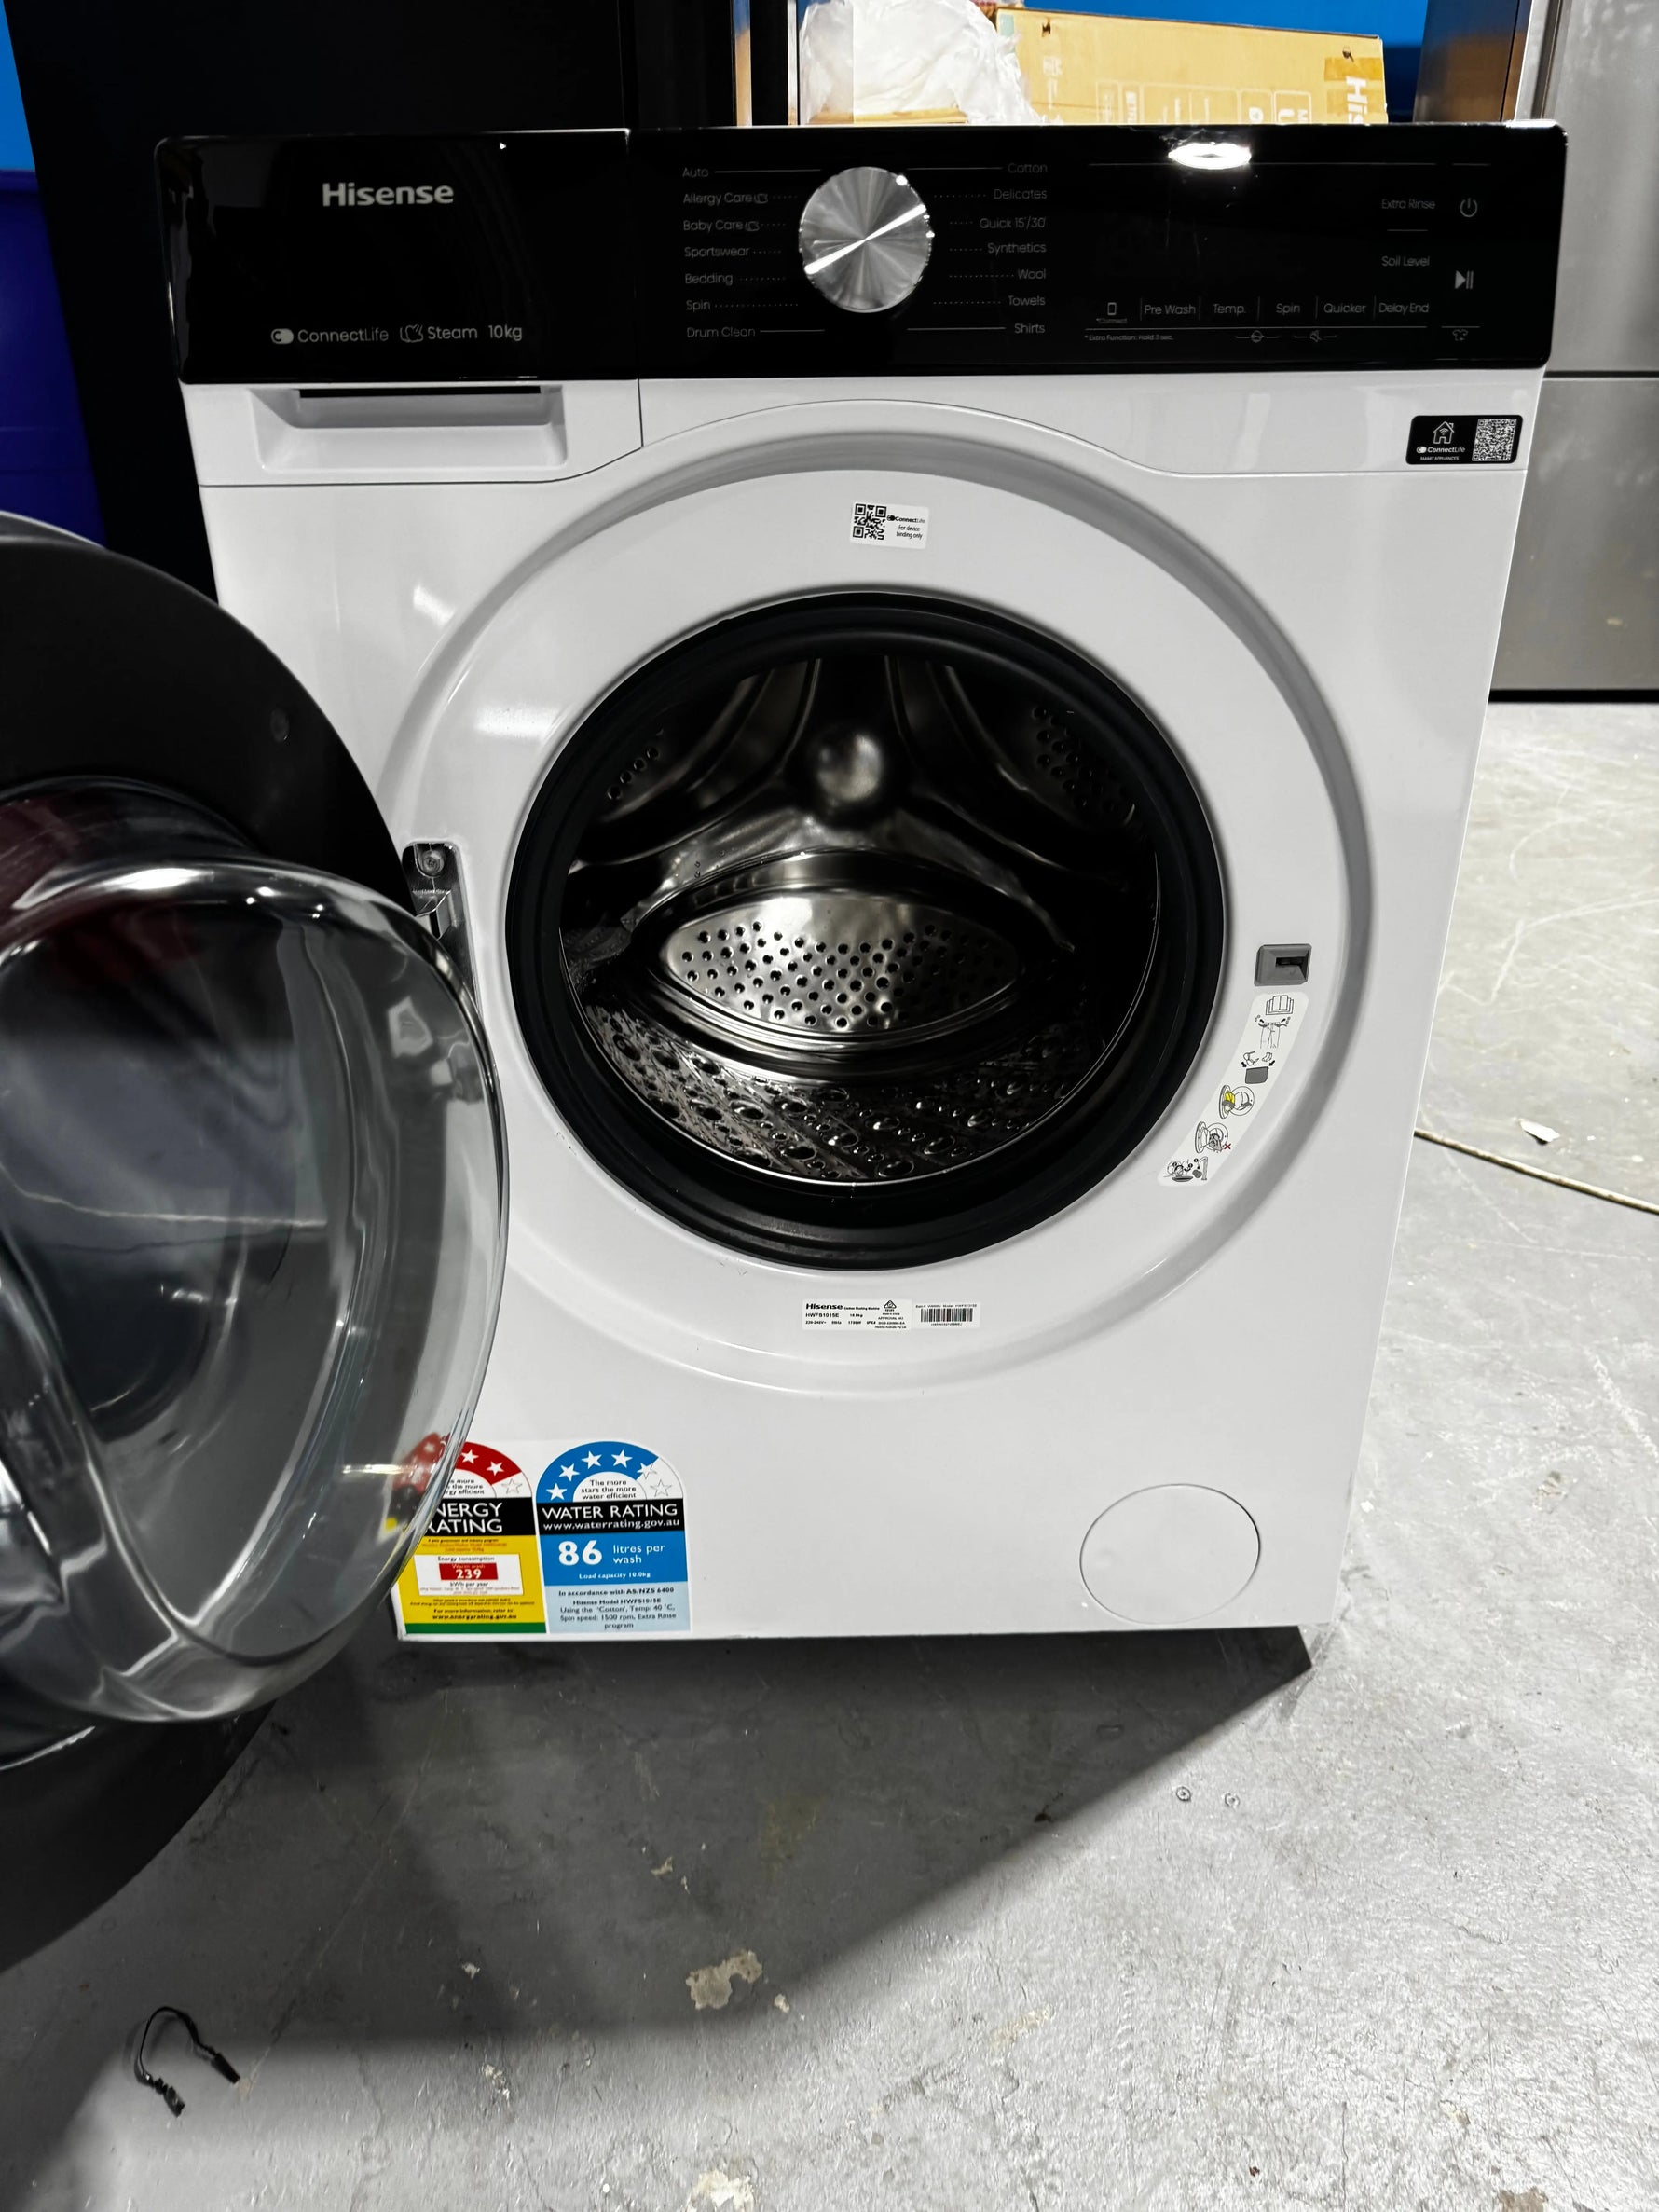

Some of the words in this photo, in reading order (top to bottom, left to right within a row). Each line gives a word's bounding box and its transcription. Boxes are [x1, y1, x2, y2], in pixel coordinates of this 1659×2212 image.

[682, 167, 708, 179] Auto
[1007, 162, 1048, 173] Cotton
[322, 181, 455, 208] Hisense
[682, 192, 722, 207] Allergy
[723, 192, 753, 204] Care
[994, 188, 1048, 199] Delicates
[1381, 199, 1407, 210] Extra
[1409, 198, 1437, 210] Rinse
[682, 219, 713, 233] Baby
[715, 218, 744, 231] Care
[979, 217, 1012, 229] Quick
[684, 246, 749, 259] Sportswear
[986, 242, 1048, 257] Synthetics
[1381, 255, 1401, 267] Soil
[1402, 255, 1431, 267] Level
[684, 272, 733, 286] Bedding
[1017, 268, 1046, 280] Wool
[686, 300, 711, 313] Spin
[1007, 295, 1046, 306] Towels
[1145, 304, 1163, 315] Pre
[1165, 304, 1197, 315] Wash
[1213, 303, 1247, 317] Temp.
[1275, 302, 1301, 317] Spin
[1323, 302, 1367, 315] Quicker
[1378, 302, 1407, 316] Delay
[1409, 302, 1430, 313] End
[296, 326, 390, 344] ConnectLife
[427, 326, 478, 340] Steam
[487, 324, 523, 341] 10kg
[686, 326, 720, 337] Drum
[721, 326, 756, 337] Clean
[1014, 323, 1046, 335] Shirts
[436, 1502, 503, 1518] NERGY
[542, 1505, 604, 1520] WATER
[610, 1503, 679, 1518] RATING
[542, 1518, 680, 1531] www.waterrating.gov.au
[557, 1540, 602, 1566] 86
[613, 1544, 642, 1554] litres
[646, 1544, 665, 1555] per
[613, 1555, 642, 1564] wash
[455, 1568, 483, 1579] 239
[604, 1622, 634, 1630] program
